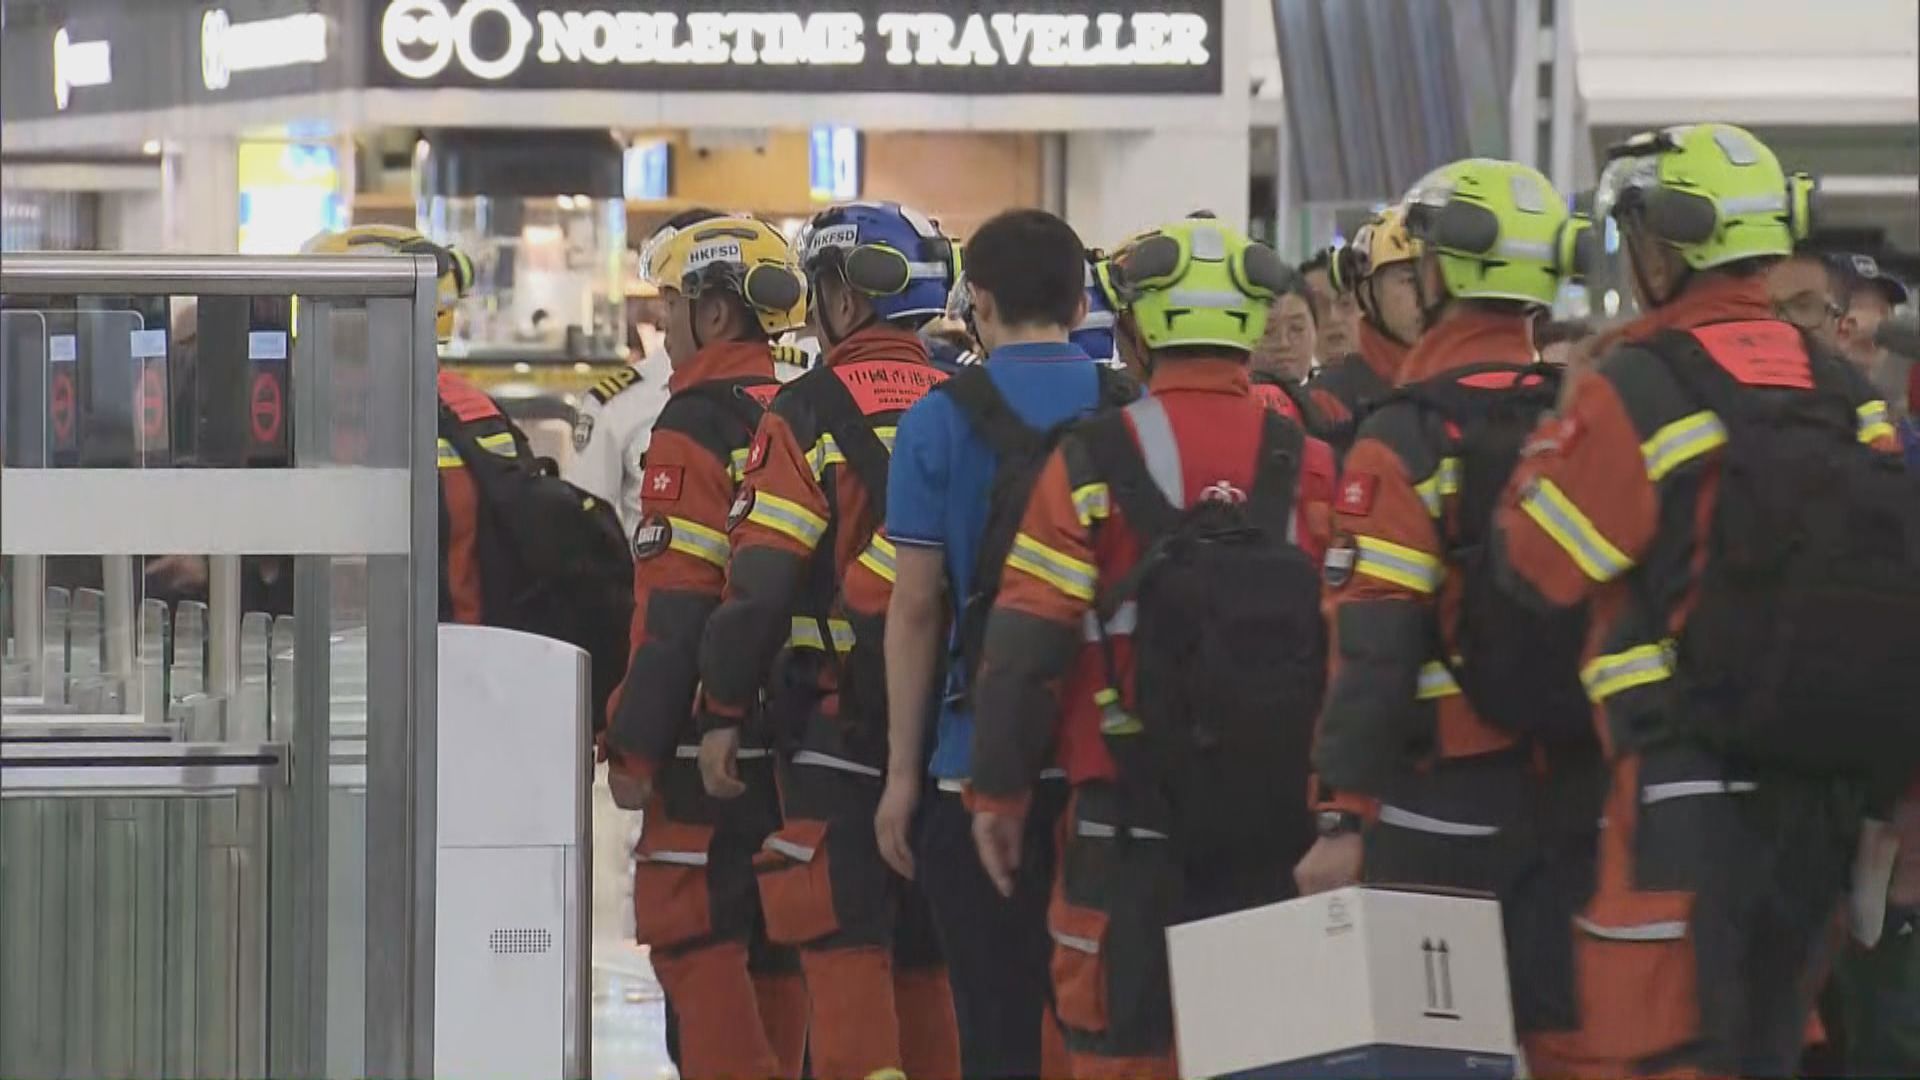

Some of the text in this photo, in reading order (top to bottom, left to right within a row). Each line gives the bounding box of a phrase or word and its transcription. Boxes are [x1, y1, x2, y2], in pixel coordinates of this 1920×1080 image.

[538, 11, 1209, 65] NOBLETIME TRAVELLER
[813, 230, 855, 248] HKFSD
[690, 245, 739, 263] HKFSD
